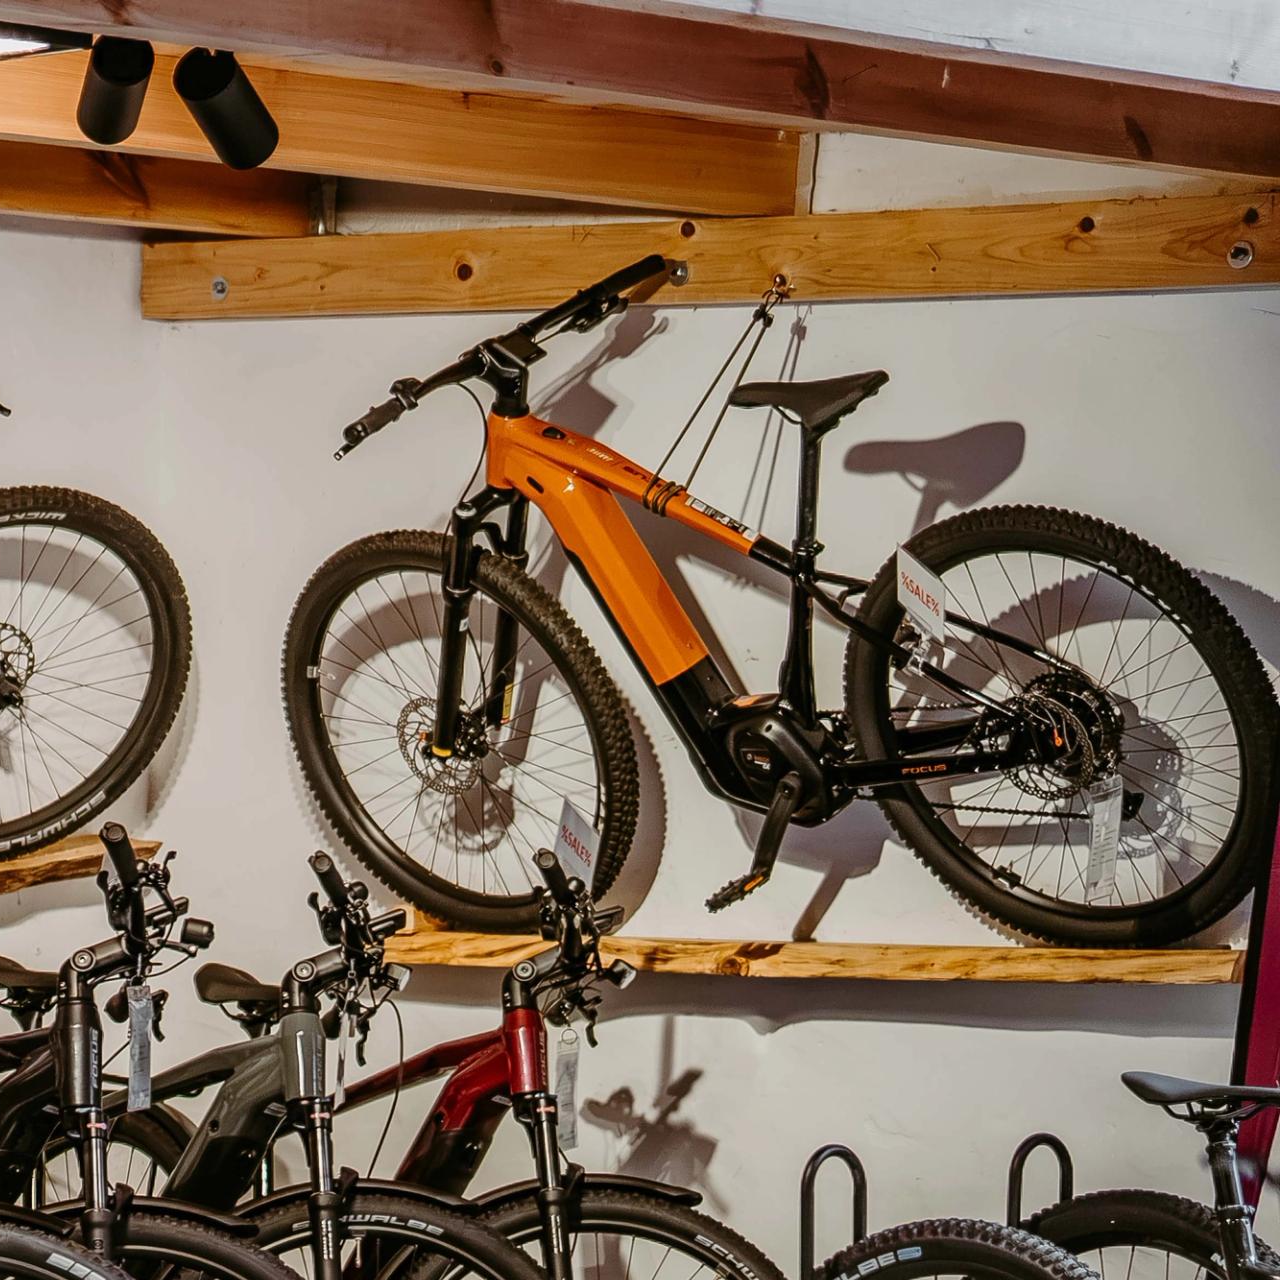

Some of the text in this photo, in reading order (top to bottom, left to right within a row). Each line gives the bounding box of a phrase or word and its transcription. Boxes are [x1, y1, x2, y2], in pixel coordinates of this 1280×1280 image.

[901, 571, 940, 617] %SALE%
[901, 764, 947, 775] FOCUS
[561, 825, 592, 867] %SALE%
[292, 1213, 444, 1236] SWALBE
